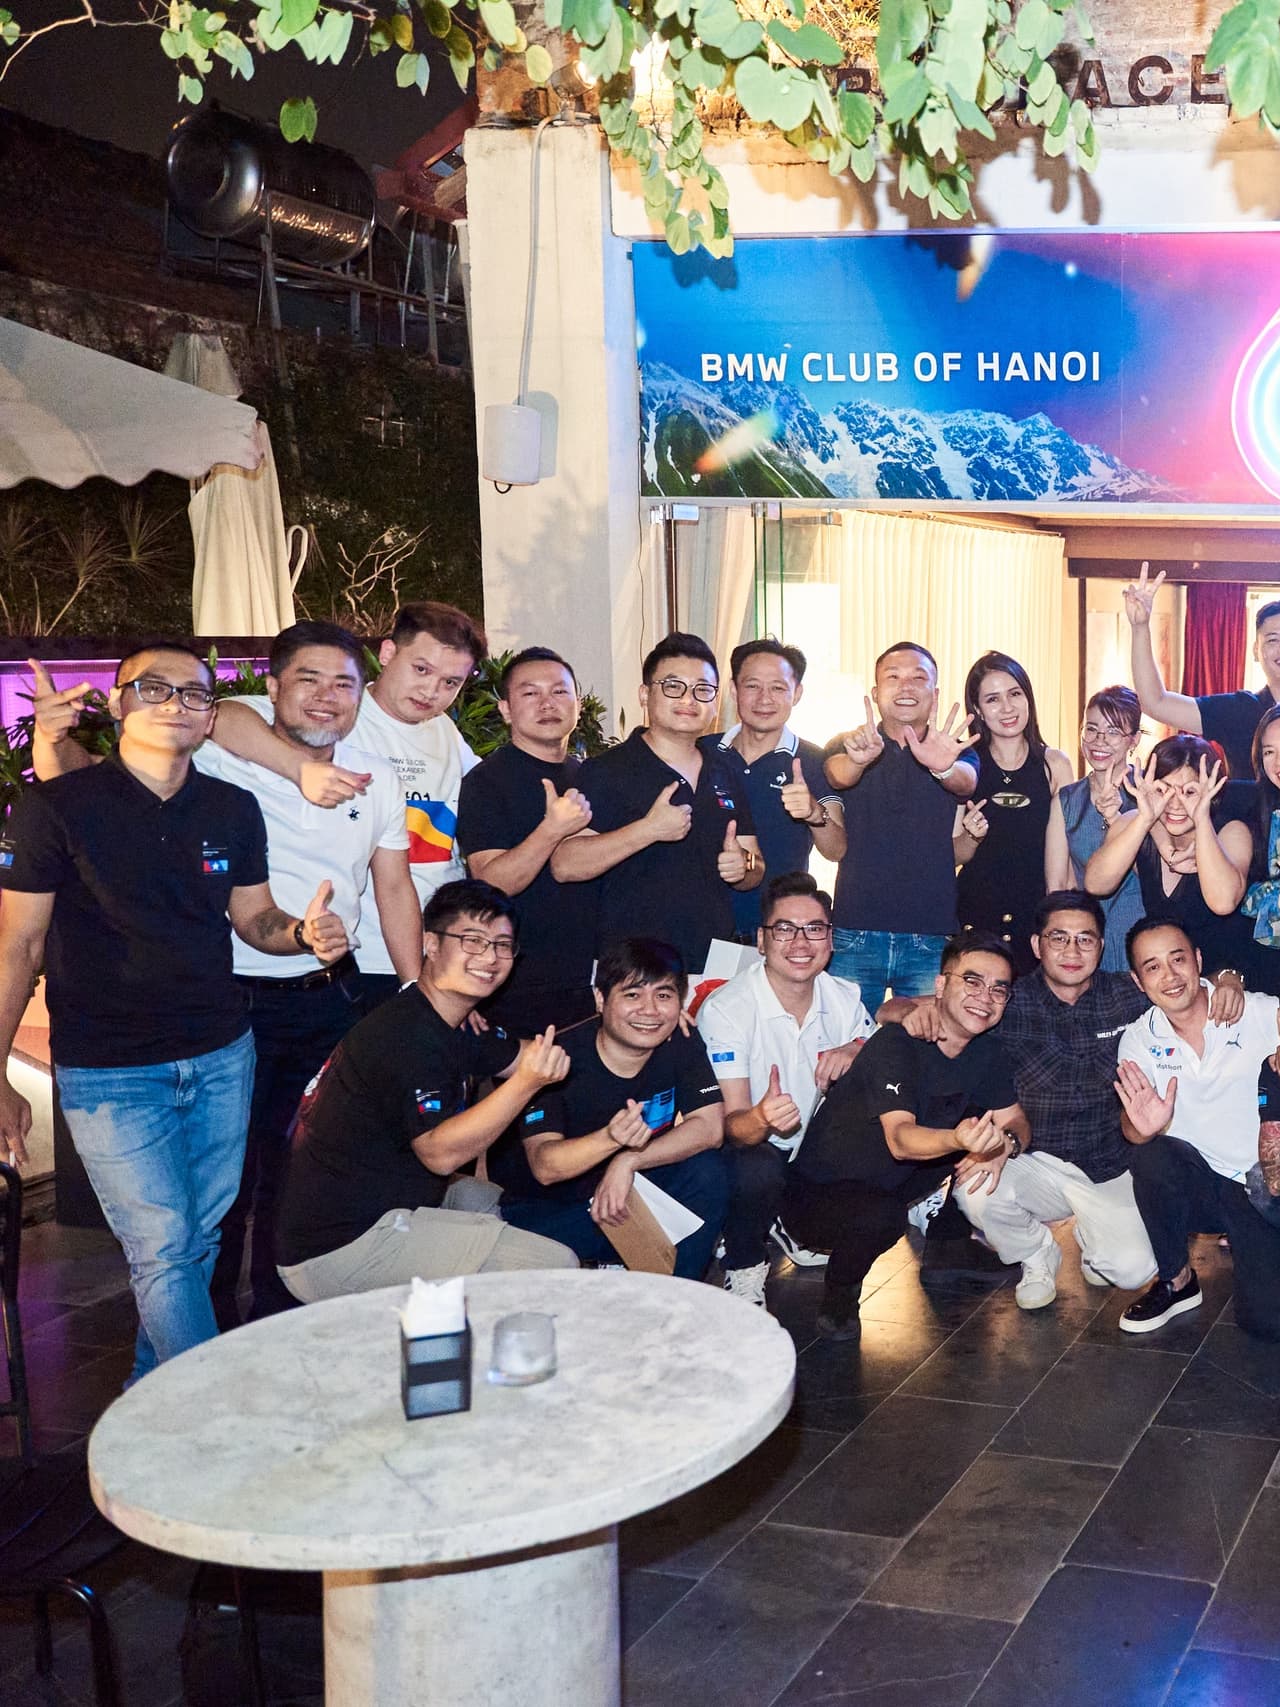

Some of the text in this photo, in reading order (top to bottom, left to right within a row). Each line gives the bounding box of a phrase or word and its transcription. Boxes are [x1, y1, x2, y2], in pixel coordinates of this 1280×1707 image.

[701, 351, 1100, 382] BMW CLUB OF HANOI
